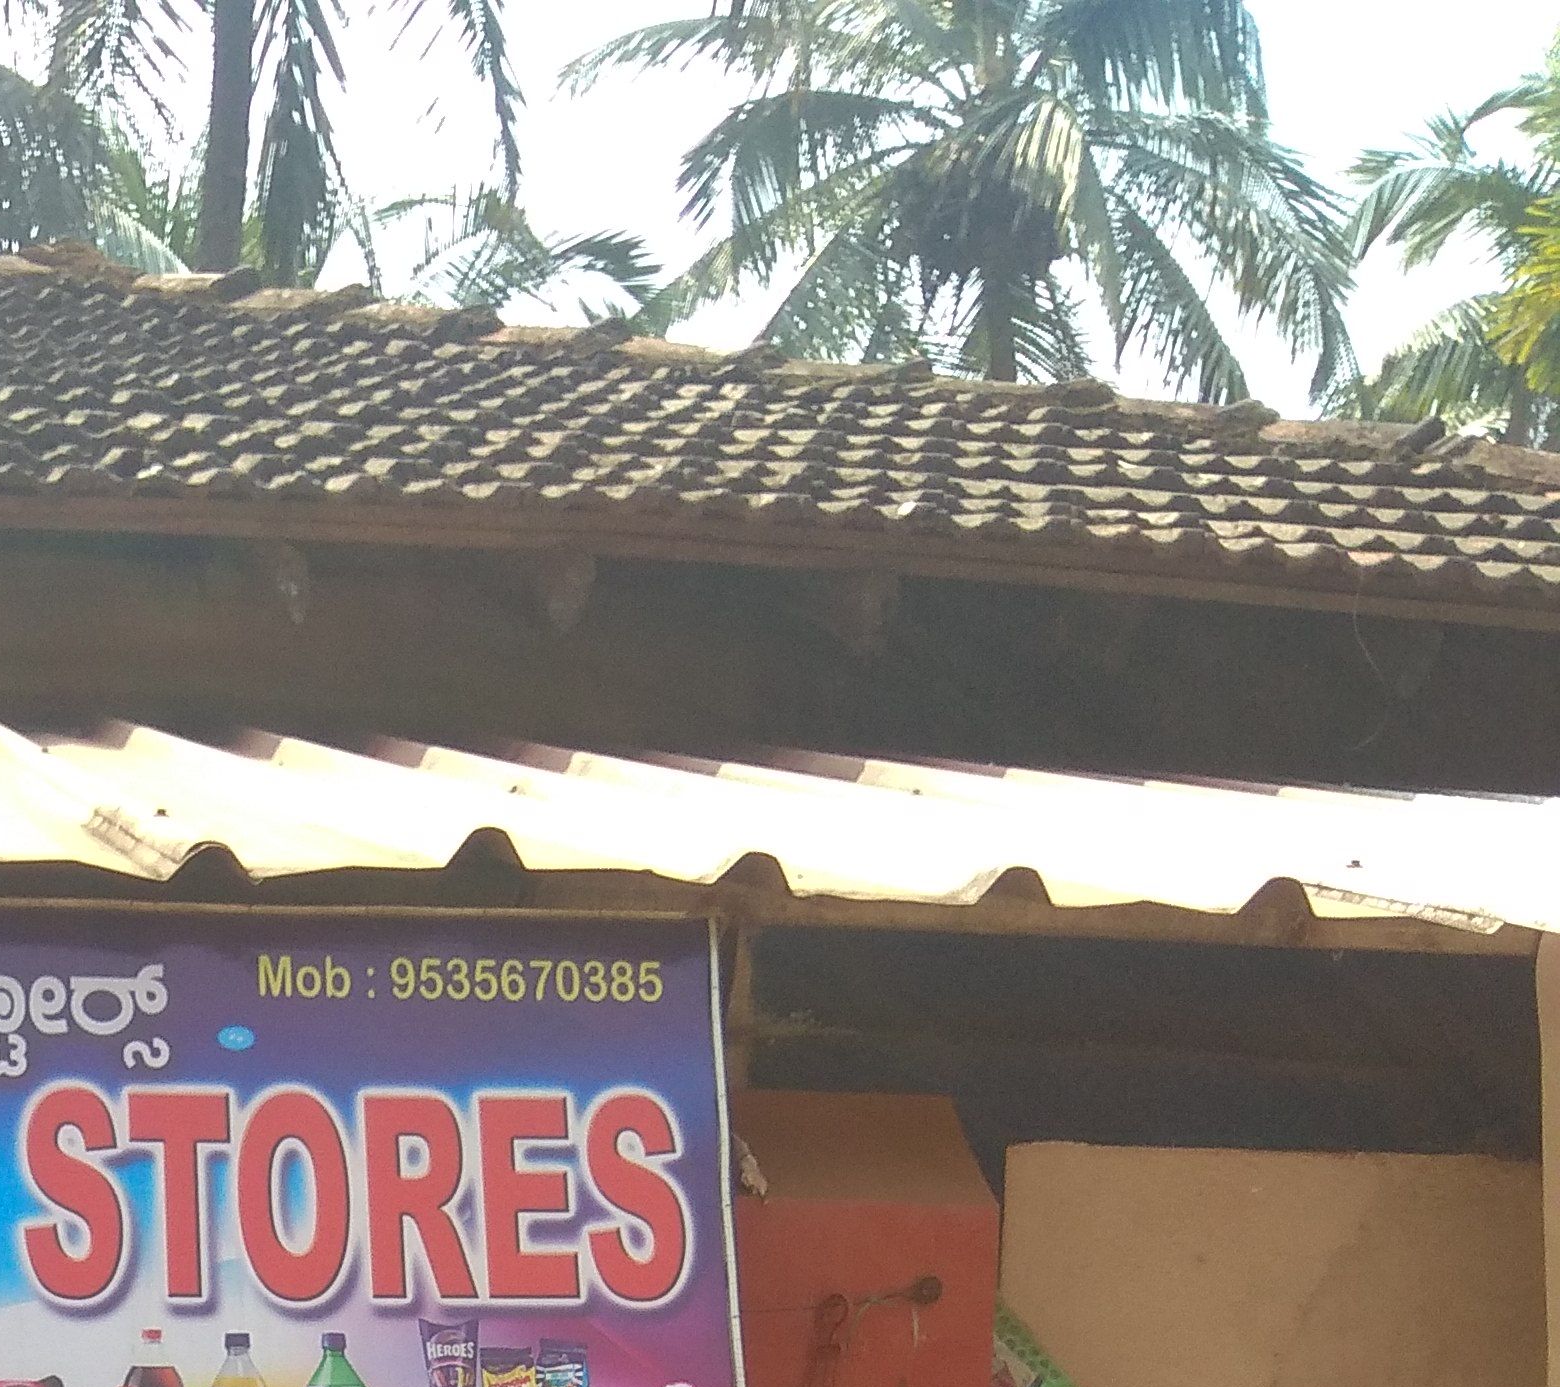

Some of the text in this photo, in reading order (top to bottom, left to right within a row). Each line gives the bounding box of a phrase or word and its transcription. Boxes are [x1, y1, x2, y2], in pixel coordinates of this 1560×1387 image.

[258, 954, 351, 998] Mob
[389, 958, 665, 1004] 9535670385
[22, 1086, 692, 1304] STORES
[426, 1341, 475, 1359] HEROES
